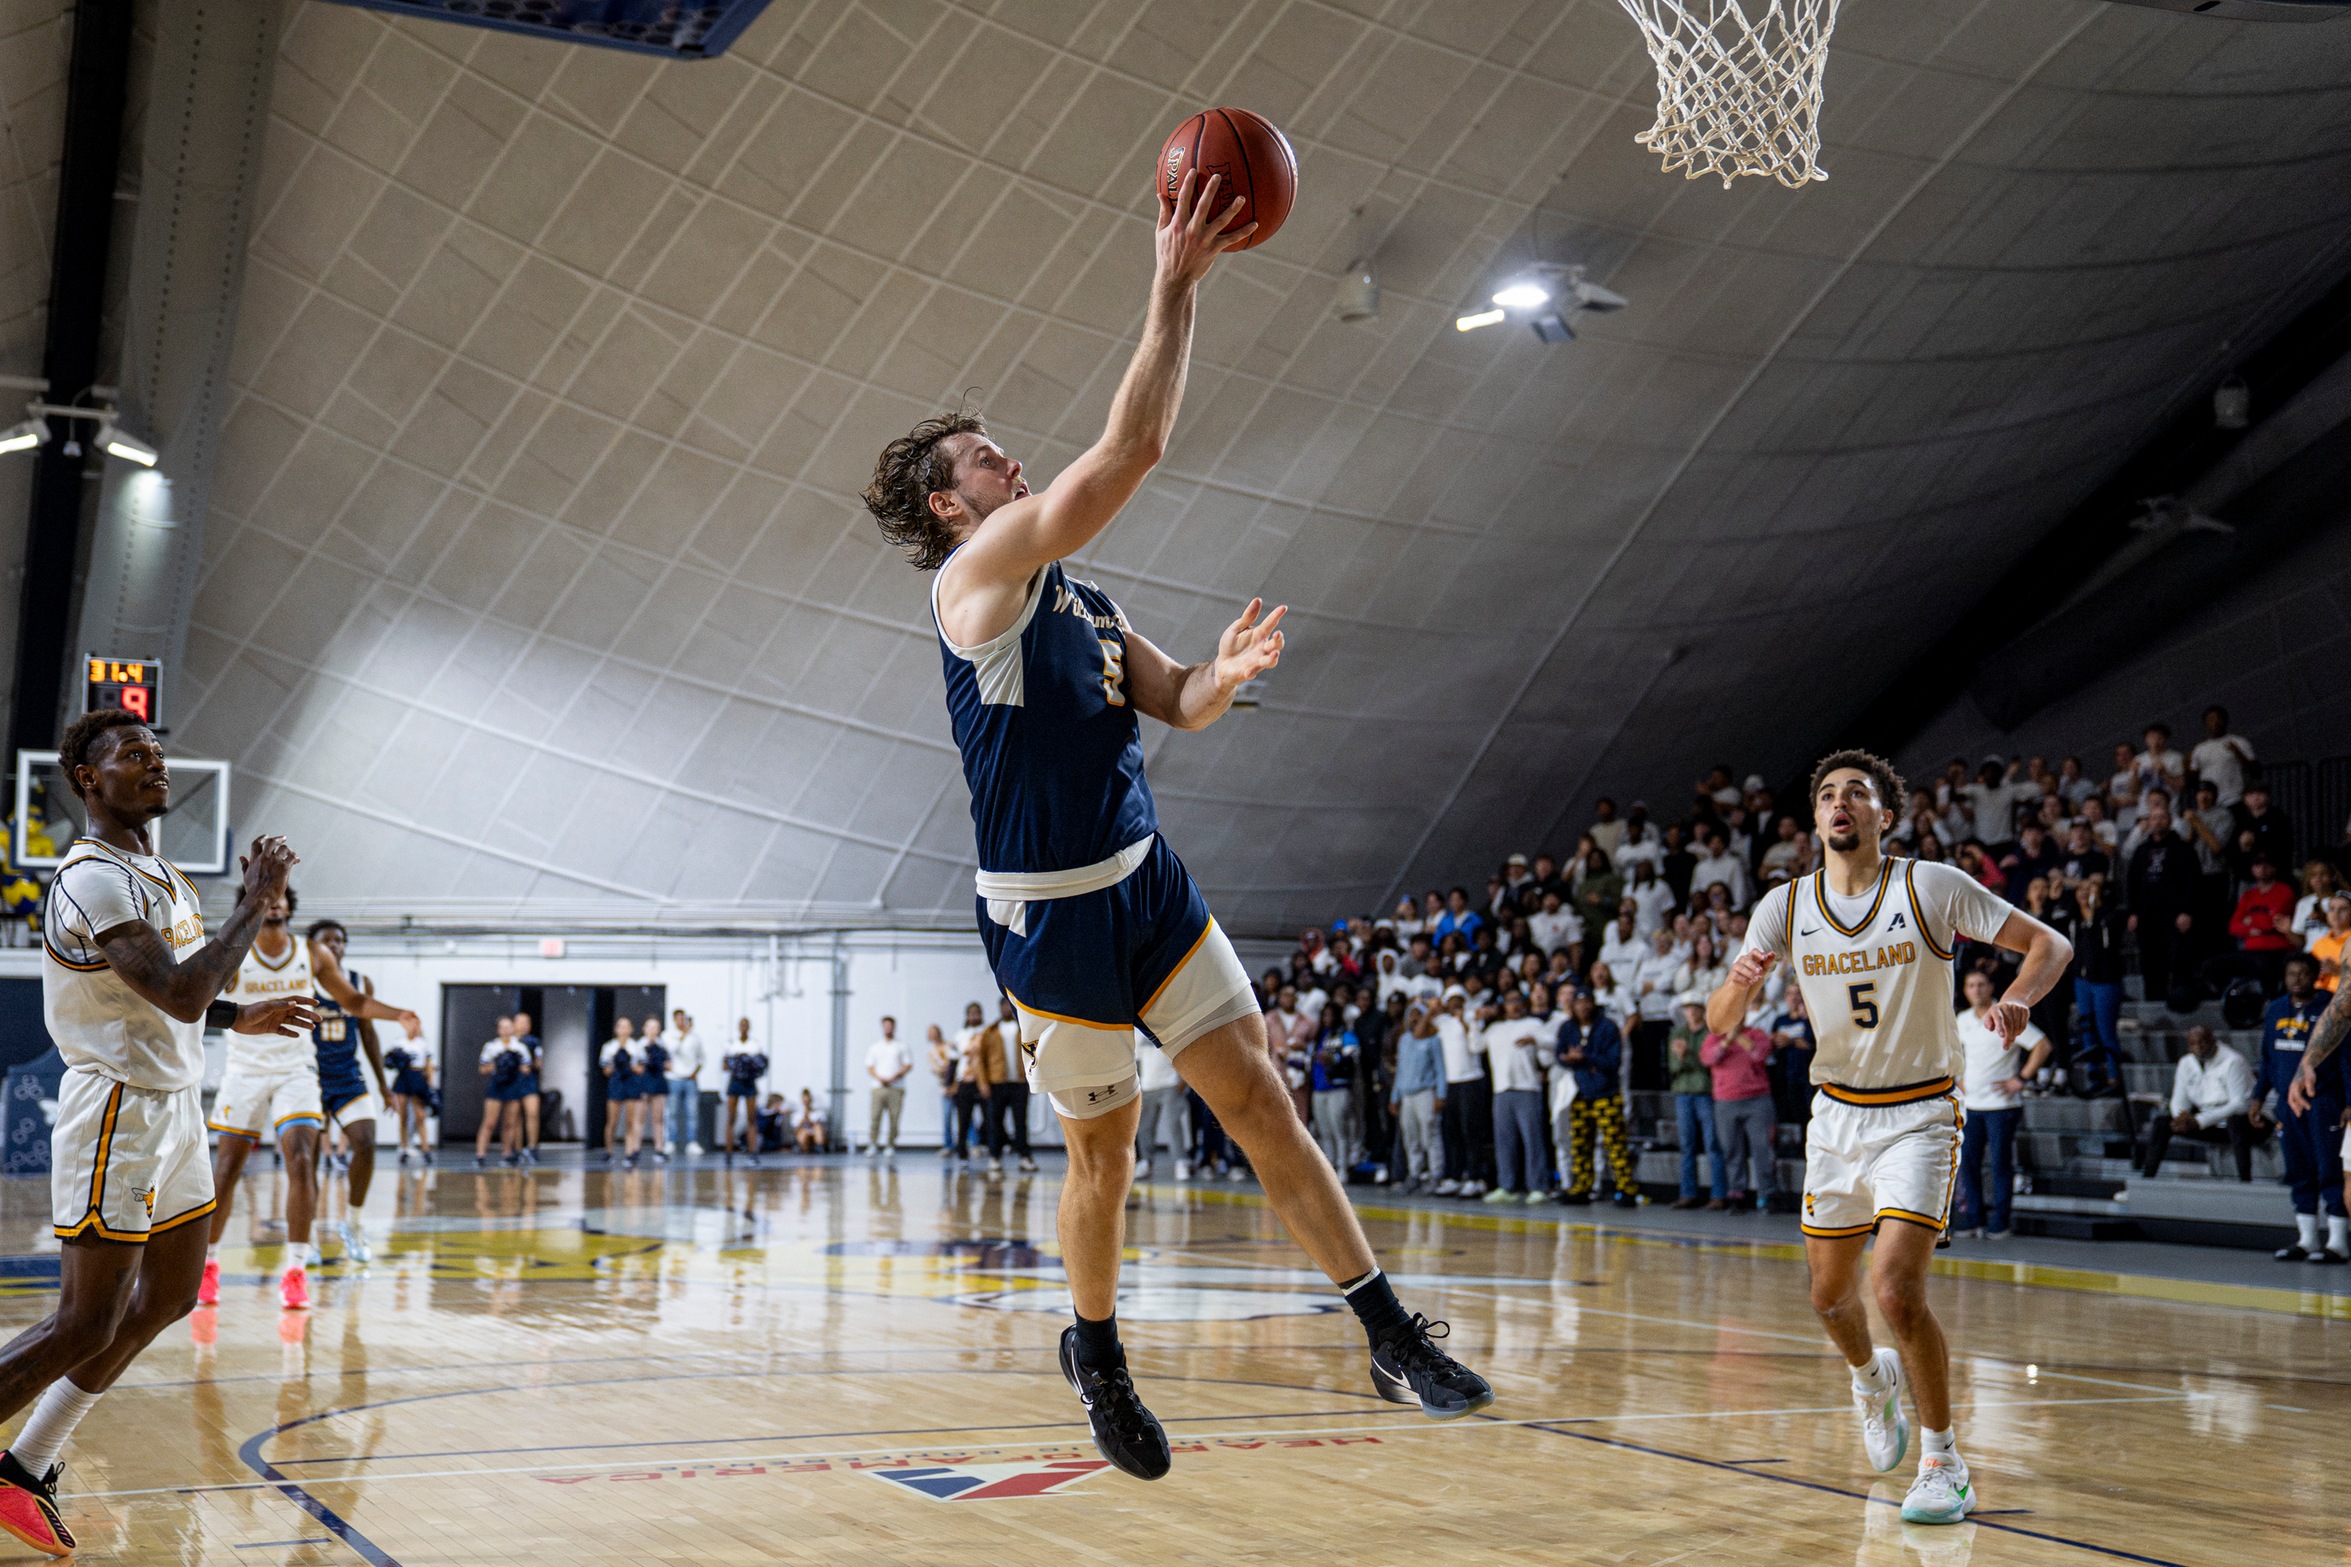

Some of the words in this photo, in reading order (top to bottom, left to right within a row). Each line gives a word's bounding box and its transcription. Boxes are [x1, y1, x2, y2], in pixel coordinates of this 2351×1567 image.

[89, 659, 143, 684] 31.4
[1802, 941, 1916, 976] GRACELAND
[1846, 979, 1882, 1032] 5
[1002, 1453, 1083, 1463] OF
[1169, 1437, 1384, 1454] HEAR
[536, 1456, 976, 1485] AMERICA
